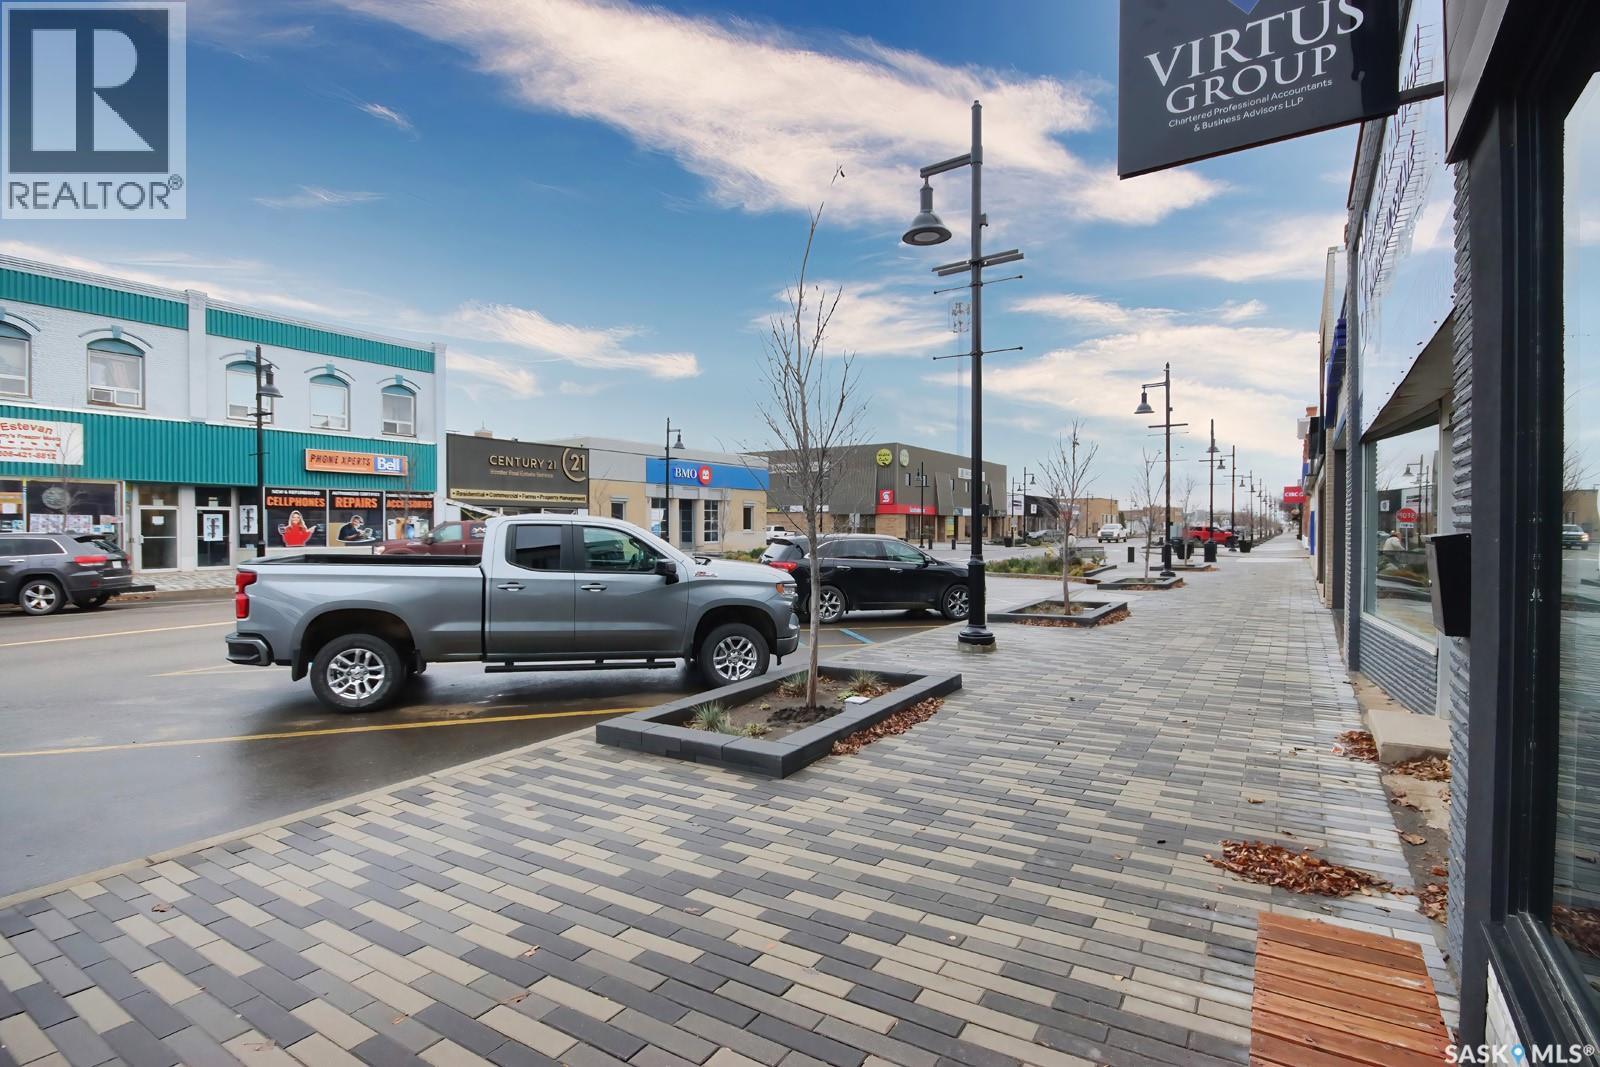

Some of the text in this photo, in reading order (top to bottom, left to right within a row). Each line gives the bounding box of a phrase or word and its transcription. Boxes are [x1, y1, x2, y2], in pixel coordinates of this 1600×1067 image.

[1144, 0, 1364, 87] VIRTUS
[1166, 44, 1337, 114] GROUP
[1168, 79, 1333, 128] Chartered Professional Accountants
[1193, 97, 1304, 132] & Business Advisors LLP
[0, 422, 53, 434] Estevan
[310, 454, 371, 466] PHONE XPERTS
[377, 457, 400, 471] Bell
[489, 455, 557, 470] CENTURY 21
[675, 467, 698, 479] BMO
[267, 496, 325, 508] CELLPHONES
[335, 496, 378, 509] REPAIRS
[489, 492, 518, 500] Commercial
